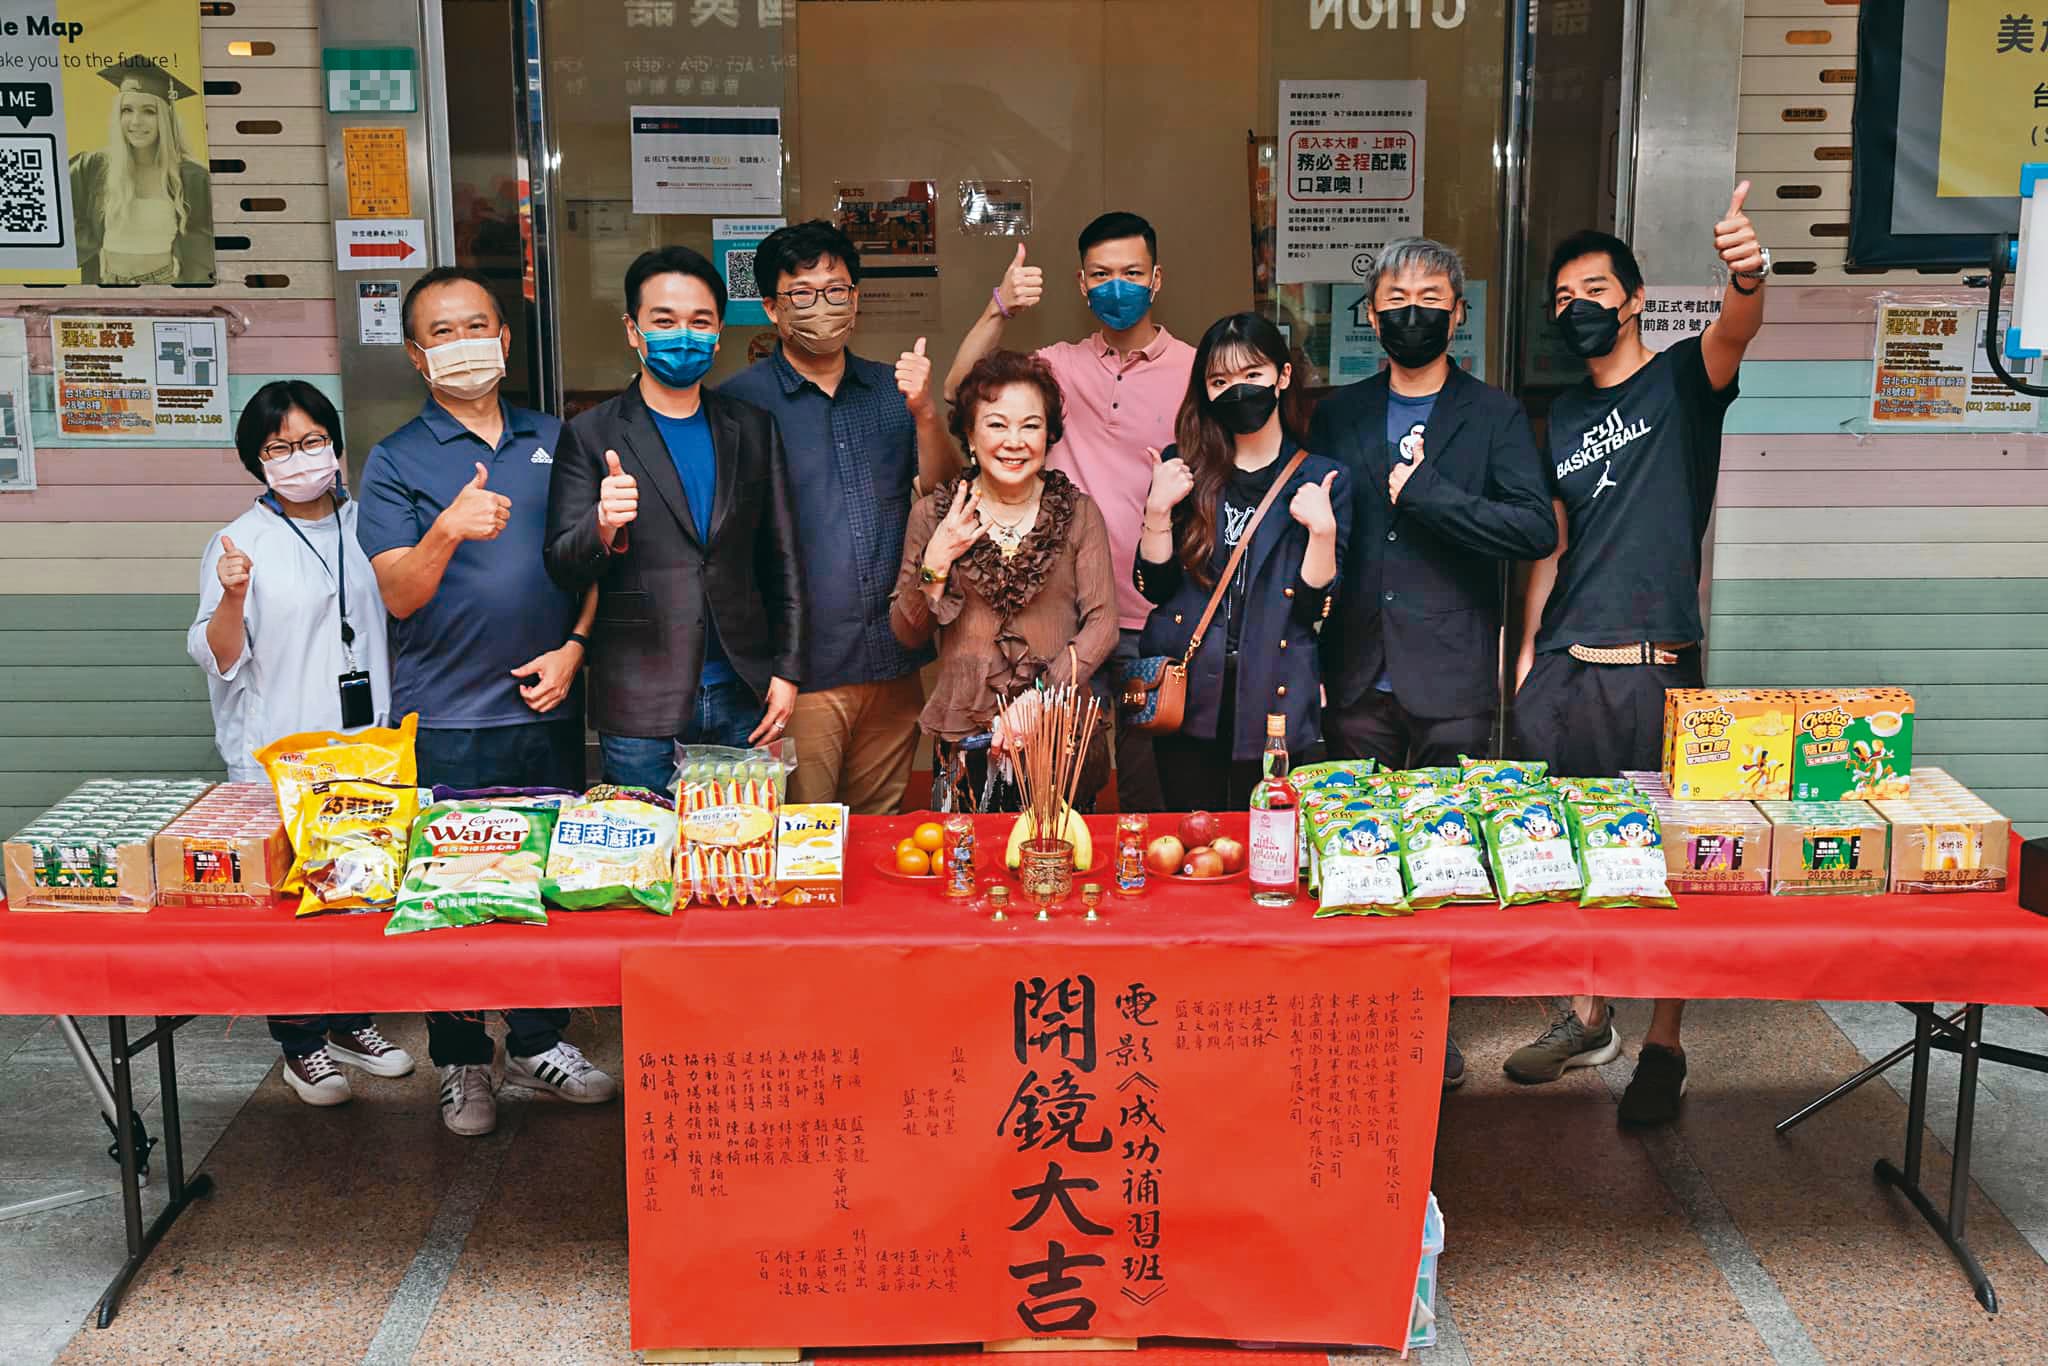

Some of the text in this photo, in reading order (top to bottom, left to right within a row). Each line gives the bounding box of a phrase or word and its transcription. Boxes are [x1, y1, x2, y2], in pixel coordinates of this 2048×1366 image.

[27, 16, 83, 43] Map
[1996, 13, 2048, 53] 美
[29, 55, 59, 72] you
[64, 53, 81, 68] to
[86, 52, 113, 68] the
[118, 52, 168, 68] future
[10, 92, 36, 107] ME
[1296, 153, 1407, 172] 務必全程配戴
[1640, 319, 1670, 333] 前路
[1673, 320, 1686, 332] 28
[1556, 418, 1652, 480] BASKETBALL
[422, 824, 528, 844] Wafer
[468, 815, 519, 827] Cream
[1410, 987, 1425, 1064] 出品公司
[639, 1052, 657, 1091] 編劇
[996, 974, 1114, 1333] 開鏡大吉
[1105, 982, 1169, 1306] 電影《成功補習班》
